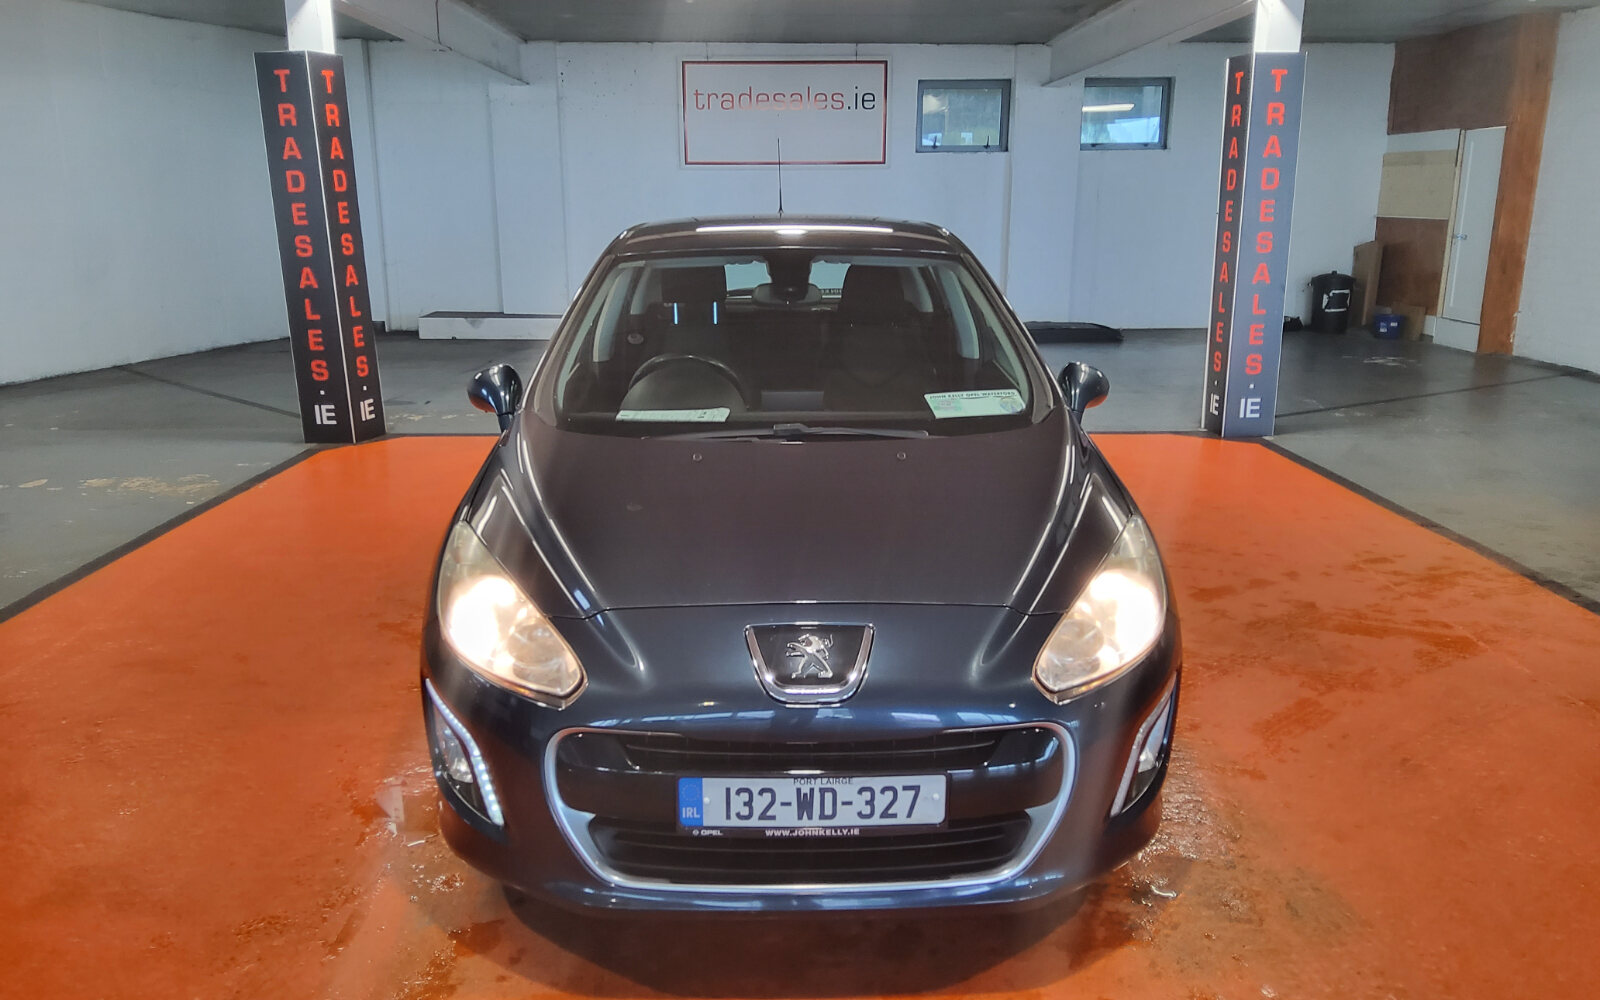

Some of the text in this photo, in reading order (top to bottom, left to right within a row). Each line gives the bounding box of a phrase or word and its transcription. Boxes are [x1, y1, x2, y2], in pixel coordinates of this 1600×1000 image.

[693, 86, 876, 110] tradesales.ie
[793, 777, 818, 785] PORT
[725, 785, 921, 821] 132-WD-327
[682, 807, 700, 818] IRL
[765, 828, 860, 837] WWW.JOHNKELLY.IE
